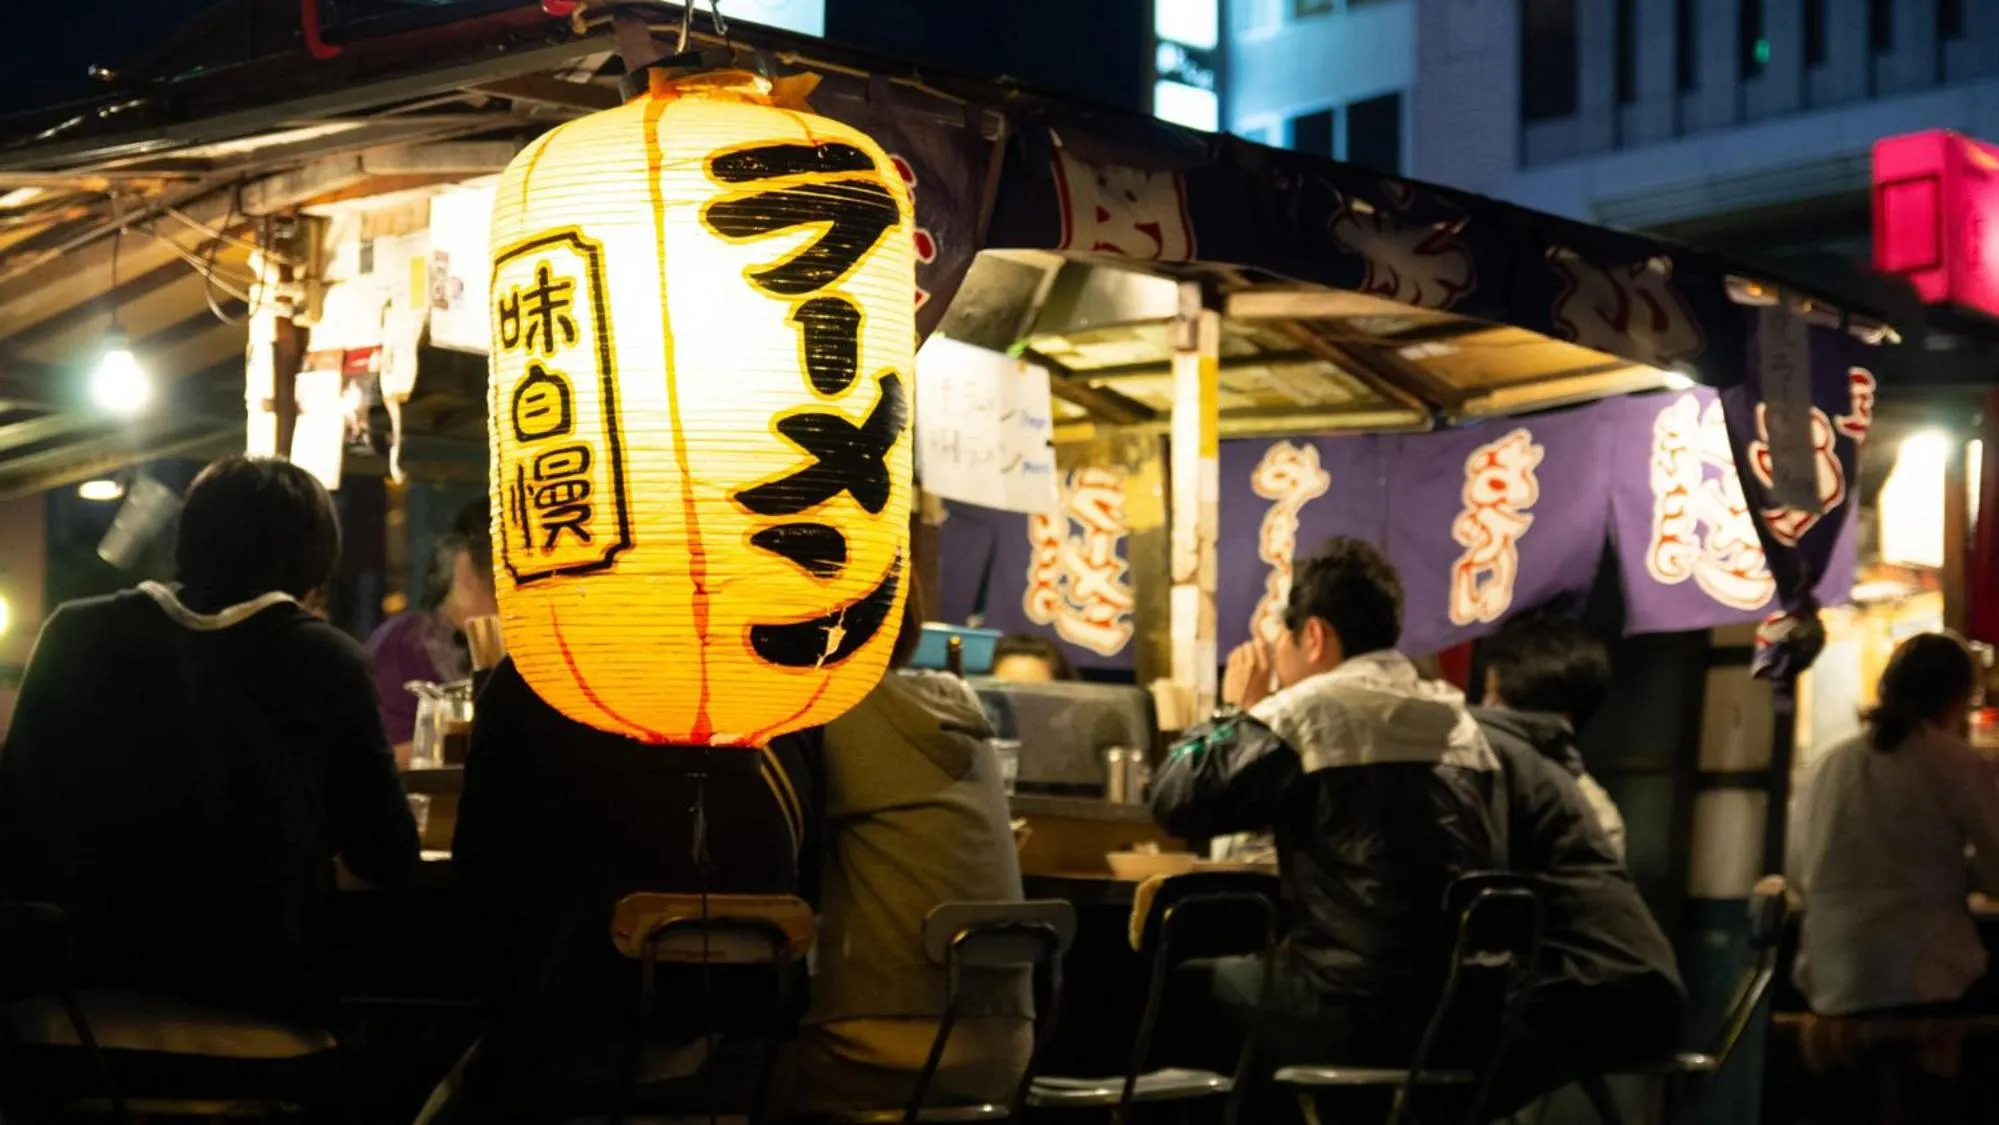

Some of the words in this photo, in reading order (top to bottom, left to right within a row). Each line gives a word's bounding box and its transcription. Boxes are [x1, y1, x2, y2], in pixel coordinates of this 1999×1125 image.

[499, 265, 592, 554] 味自慢
[704, 141, 908, 667] ラーメン
